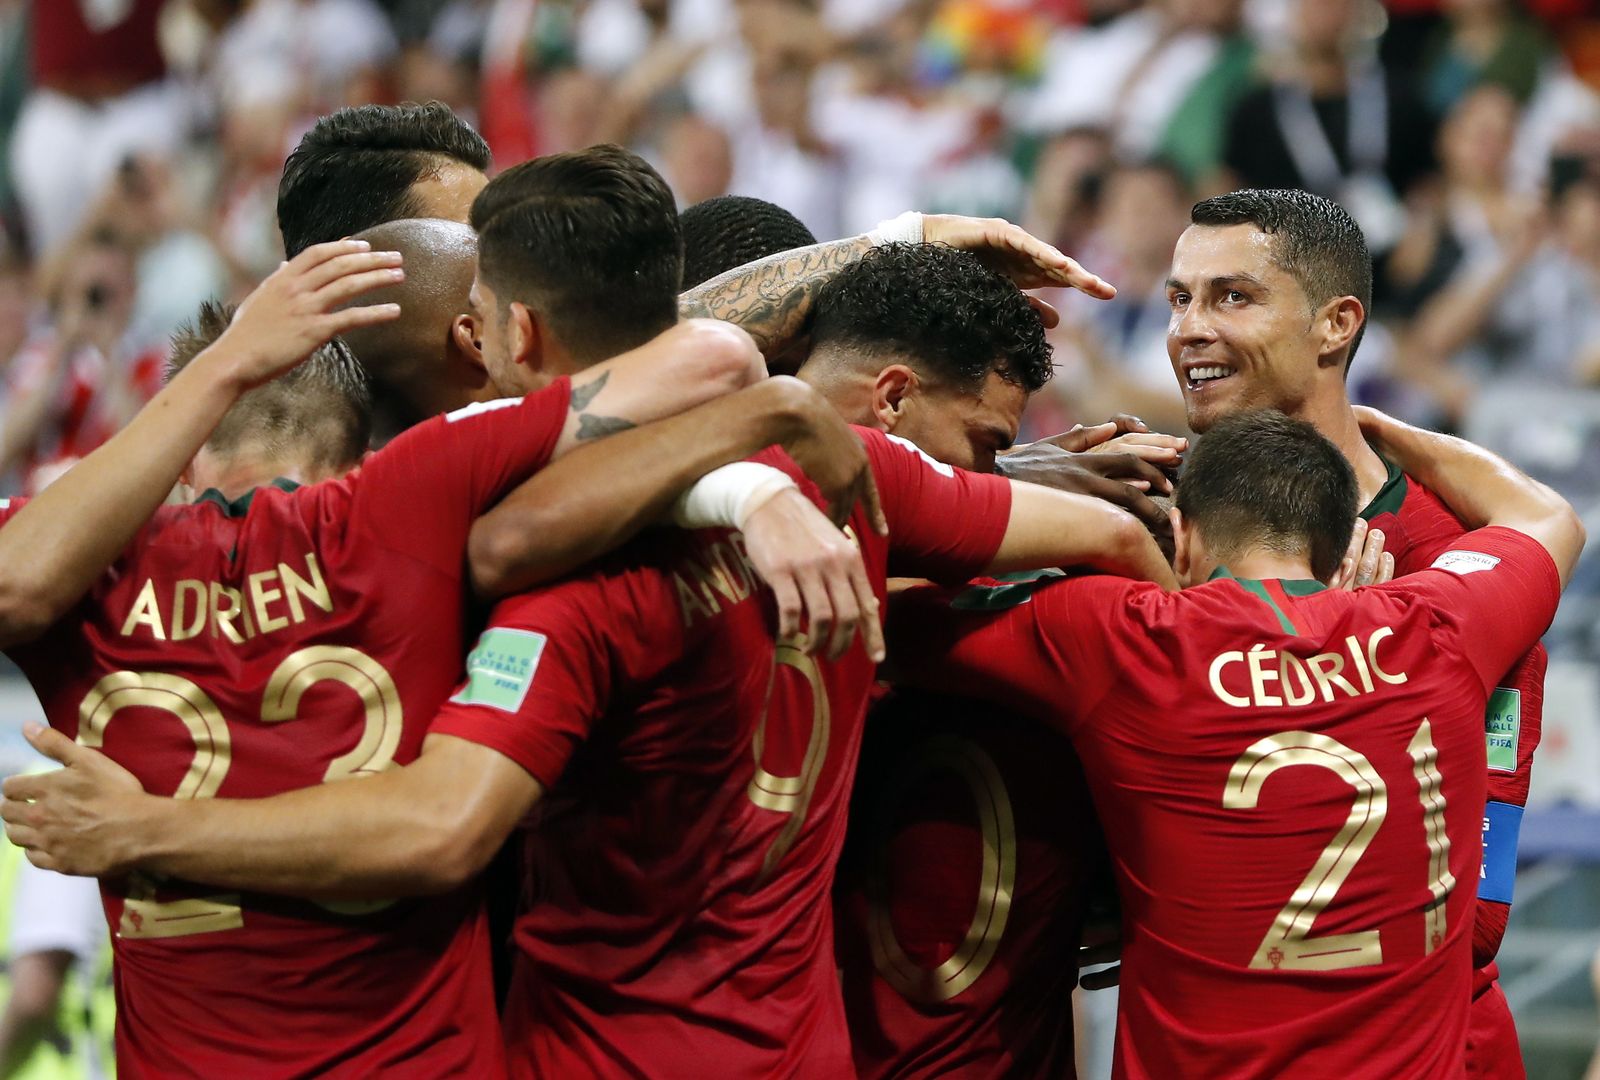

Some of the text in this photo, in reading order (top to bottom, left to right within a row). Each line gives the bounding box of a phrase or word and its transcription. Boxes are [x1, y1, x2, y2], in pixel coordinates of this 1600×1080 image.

[120, 552, 333, 645] ADRIEN
[495, 679, 518, 691] FIFA
[1208, 626, 1408, 707] CÉDRIC
[747, 632, 831, 887] 9
[1490, 738, 1512, 749] FIFA
[1222, 716, 1456, 970] 21
